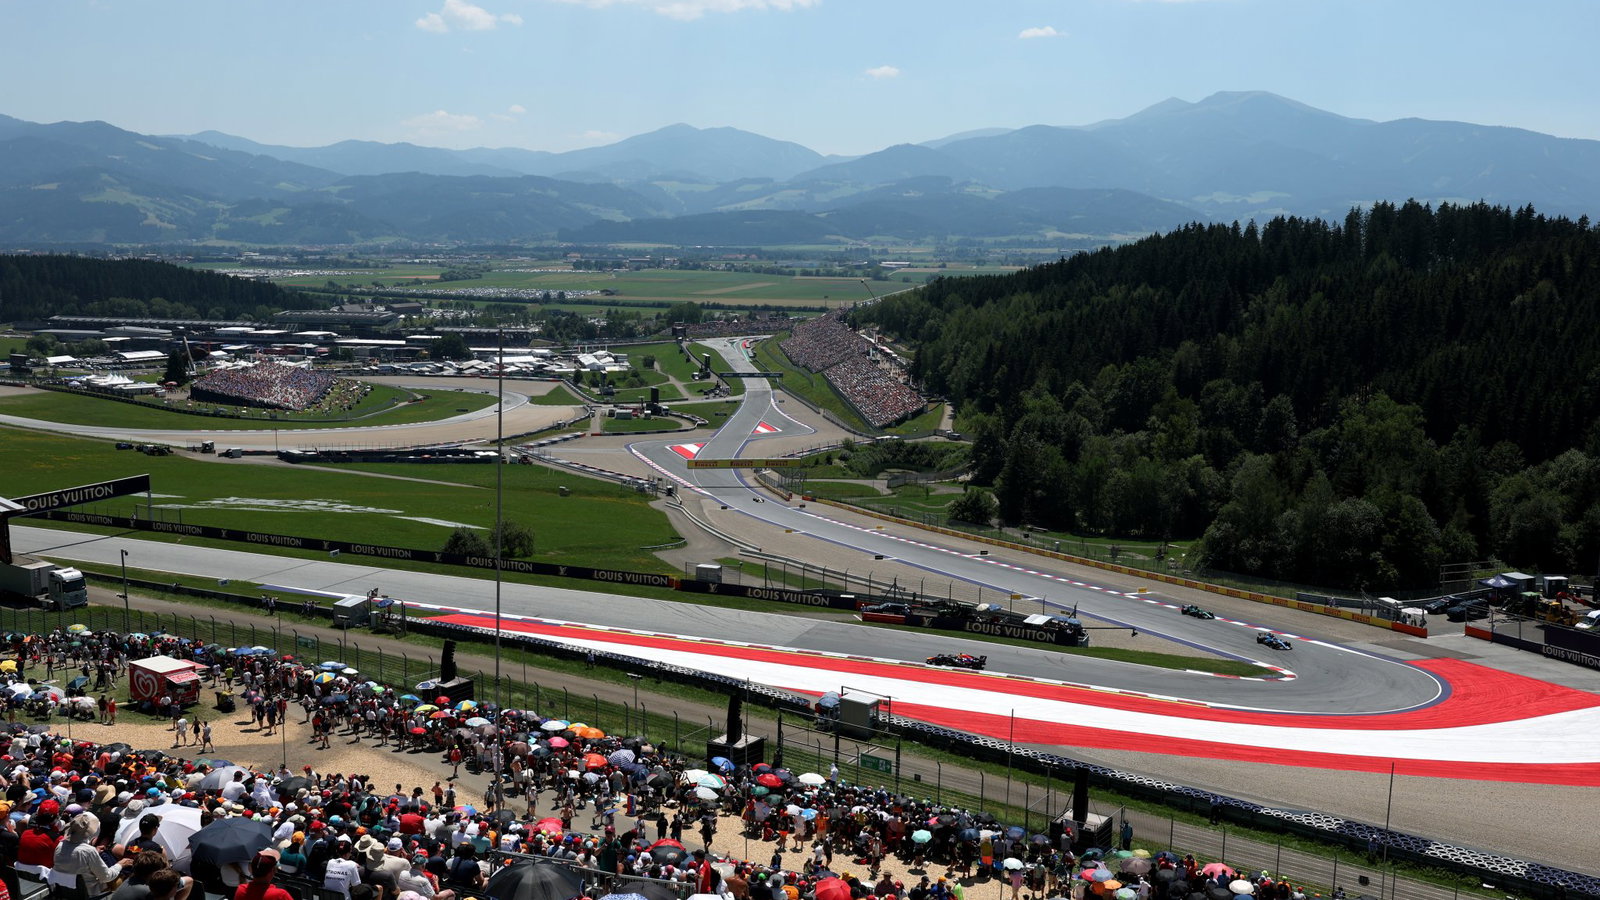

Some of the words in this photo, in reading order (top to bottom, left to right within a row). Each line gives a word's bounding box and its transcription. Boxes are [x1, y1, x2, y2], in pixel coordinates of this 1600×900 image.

[62, 484, 114, 504] VUITTON
[68, 513, 86, 521] LOUIS
[86, 515, 113, 525] VUITTON
[152, 522, 172, 532] LOUIS
[173, 524, 202, 534] VUITTON
[246, 533, 269, 543] LOUIS
[269, 535, 302, 547] VUITTON
[351, 544, 375, 555] LOUIS
[376, 547, 412, 559] VUITTON
[466, 556, 493, 567] LOUIS
[594, 569, 623, 582] LOUIS
[625, 572, 668, 585] VUITTON
[746, 587, 779, 601] LOUIS
[782, 591, 830, 606] VUITTON
[966, 621, 1001, 636] LOUIS
[1004, 626, 1056, 643] VUITTON
[1542, 646, 1566, 659] LOUIS
[1567, 652, 1600, 667] VUITTON
